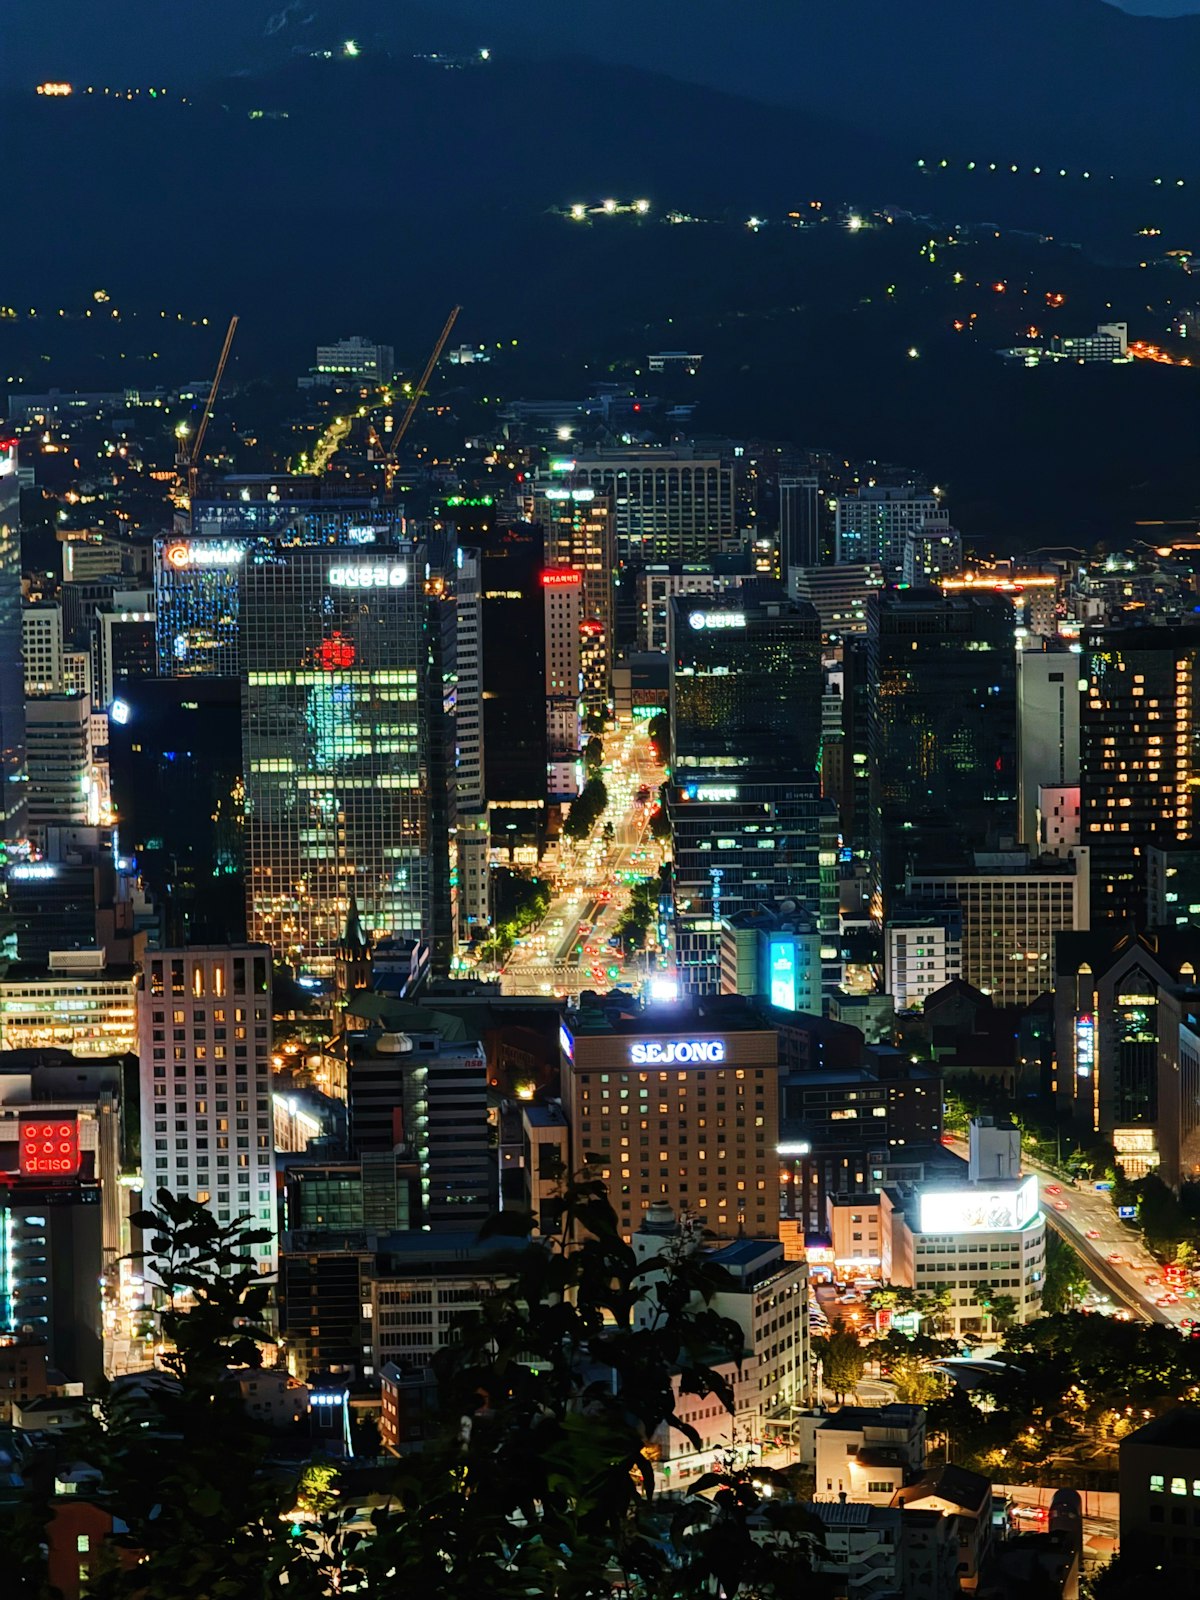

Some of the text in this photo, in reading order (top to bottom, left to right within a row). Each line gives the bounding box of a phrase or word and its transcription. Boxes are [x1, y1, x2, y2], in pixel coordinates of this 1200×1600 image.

[188, 547, 243, 563] Hanwh
[329, 566, 389, 588] 대신증권
[631, 1041, 725, 1064] SEJONG
[25, 1157, 71, 1171] daiso
